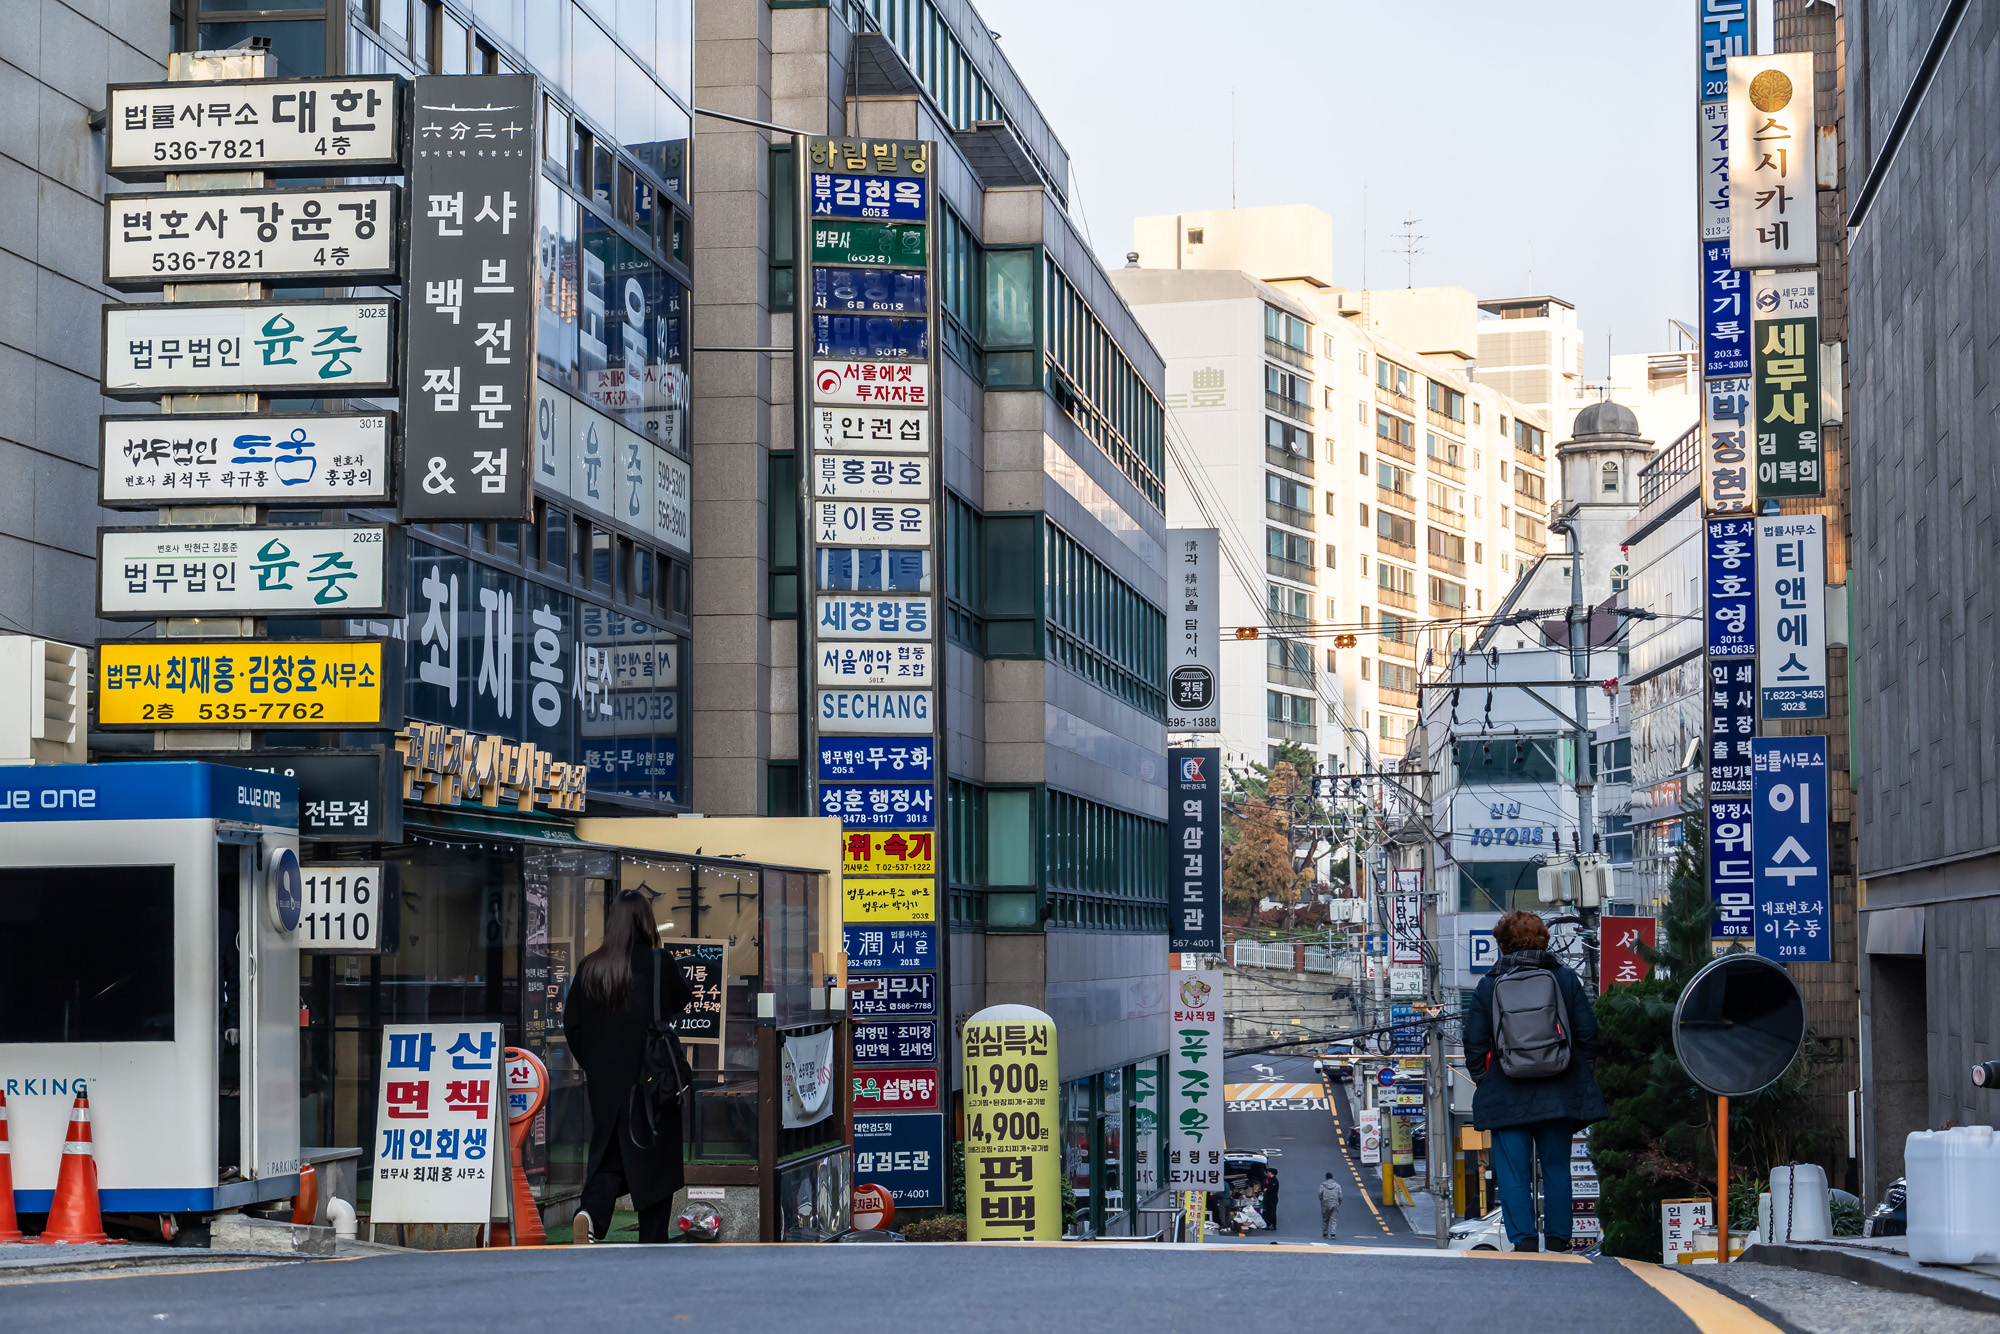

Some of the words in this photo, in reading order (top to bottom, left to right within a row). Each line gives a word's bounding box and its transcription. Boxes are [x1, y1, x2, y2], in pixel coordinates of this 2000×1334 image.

[125, 103, 258, 130] 법률사무소
[272, 89, 381, 133] 대한
[421, 121, 523, 140] 六分三十
[153, 139, 266, 160] 536-7821
[314, 136, 351, 156] 4층
[810, 140, 926, 173] 하림빌딩
[1753, 118, 1794, 250] 스시카네
[815, 175, 832, 215] 법무사
[834, 178, 921, 208] 김현옥
[123, 209, 228, 242] 변호사
[240, 199, 378, 243] 강윤경
[862, 207, 889, 217] 605호
[816, 230, 850, 248] 법무사
[152, 250, 265, 271] 536-7821
[313, 246, 350, 266] 4층
[1782, 287, 1815, 298] 세무그룹
[358, 307, 387, 319] 302호
[1710, 269, 1745, 344] 김기록
[129, 337, 240, 369] 법무법인
[254, 313, 362, 379] 윤중
[1714, 349, 1742, 359] 203호
[844, 364, 912, 383] 서울에셋
[1708, 360, 1749, 370] 535-3303
[1762, 323, 1809, 425] 세무사
[856, 385, 925, 403] 투자자문
[1710, 378, 1750, 394] 변호사
[359, 419, 384, 429] 301호
[842, 417, 920, 441] 안권섭
[123, 437, 218, 467] 법무법인
[231, 428, 317, 485] 도움
[1711, 394, 1750, 500] 박정현
[333, 454, 364, 467] 변호사
[125, 475, 156, 487] 변호사
[162, 471, 212, 489] 최석두
[221, 471, 269, 488] 곽규홍
[324, 469, 373, 487] 홍광의
[822, 458, 836, 495] 법무사
[842, 459, 921, 485] 홍광호
[1758, 459, 1818, 484] 이복희
[822, 504, 837, 541] 법무사
[843, 506, 922, 532] 이동윤
[1709, 521, 1755, 538] 변호사
[1763, 524, 1816, 537] 법률사무소
[157, 544, 179, 553] 변호사
[184, 542, 210, 553] 박현근
[353, 532, 382, 544] 202호
[124, 563, 236, 594] 법무법인
[249, 537, 358, 605] 윤중
[1712, 540, 1751, 634] 홍호영
[821, 602, 926, 632] 세창합동
[1775, 539, 1810, 682] 티앤에스
[420, 564, 564, 727] 최재홍
[1185, 619, 1199, 658] 담아서
[1720, 635, 1744, 643] 301호
[1710, 645, 1755, 655] 508-0635
[824, 649, 892, 675] 서울생약
[898, 647, 925, 661] 협동
[898, 663, 925, 677] 조합
[107, 664, 161, 690] 법무사
[322, 662, 375, 689] 사무소
[1763, 690, 1825, 701] T.6223-3453
[142, 703, 175, 720] 2층
[199, 703, 324, 720] 535-7762
[822, 694, 927, 719] SECHANG
[1781, 702, 1807, 712] 302호
[1168, 717, 1217, 727] 595-1388
[822, 750, 864, 765] 법무법인
[866, 747, 931, 771] 무궁화
[1754, 750, 1824, 772] 법률사무소
[832, 766, 854, 774] 205호
[822, 789, 864, 812] 성훈
[868, 789, 933, 812] 행정사
[305, 801, 368, 826] 전문점
[906, 814, 928, 823] 301호
[1183, 799, 1204, 931] 역삼검도관
[862, 901, 889, 912] 법무사
[1762, 900, 1824, 916] 대표변호사
[1723, 925, 1748, 935] 501호
[1764, 919, 1822, 939] 이수동
[1779, 946, 1807, 956] 201호
[900, 958, 920, 966] 201호
[1174, 1011, 1216, 1022] 본사직영
[965, 1025, 1048, 1058] 점심특선
[1227, 1098, 1330, 1112] 좌회전금지
[381, 1128, 487, 1160] 개인회생
[380, 1168, 409, 1180] 법무사
[413, 1166, 453, 1182] 최재홍
[456, 1167, 485, 1180] 사무소
[1170, 1169, 1221, 1184] 도가니탕
